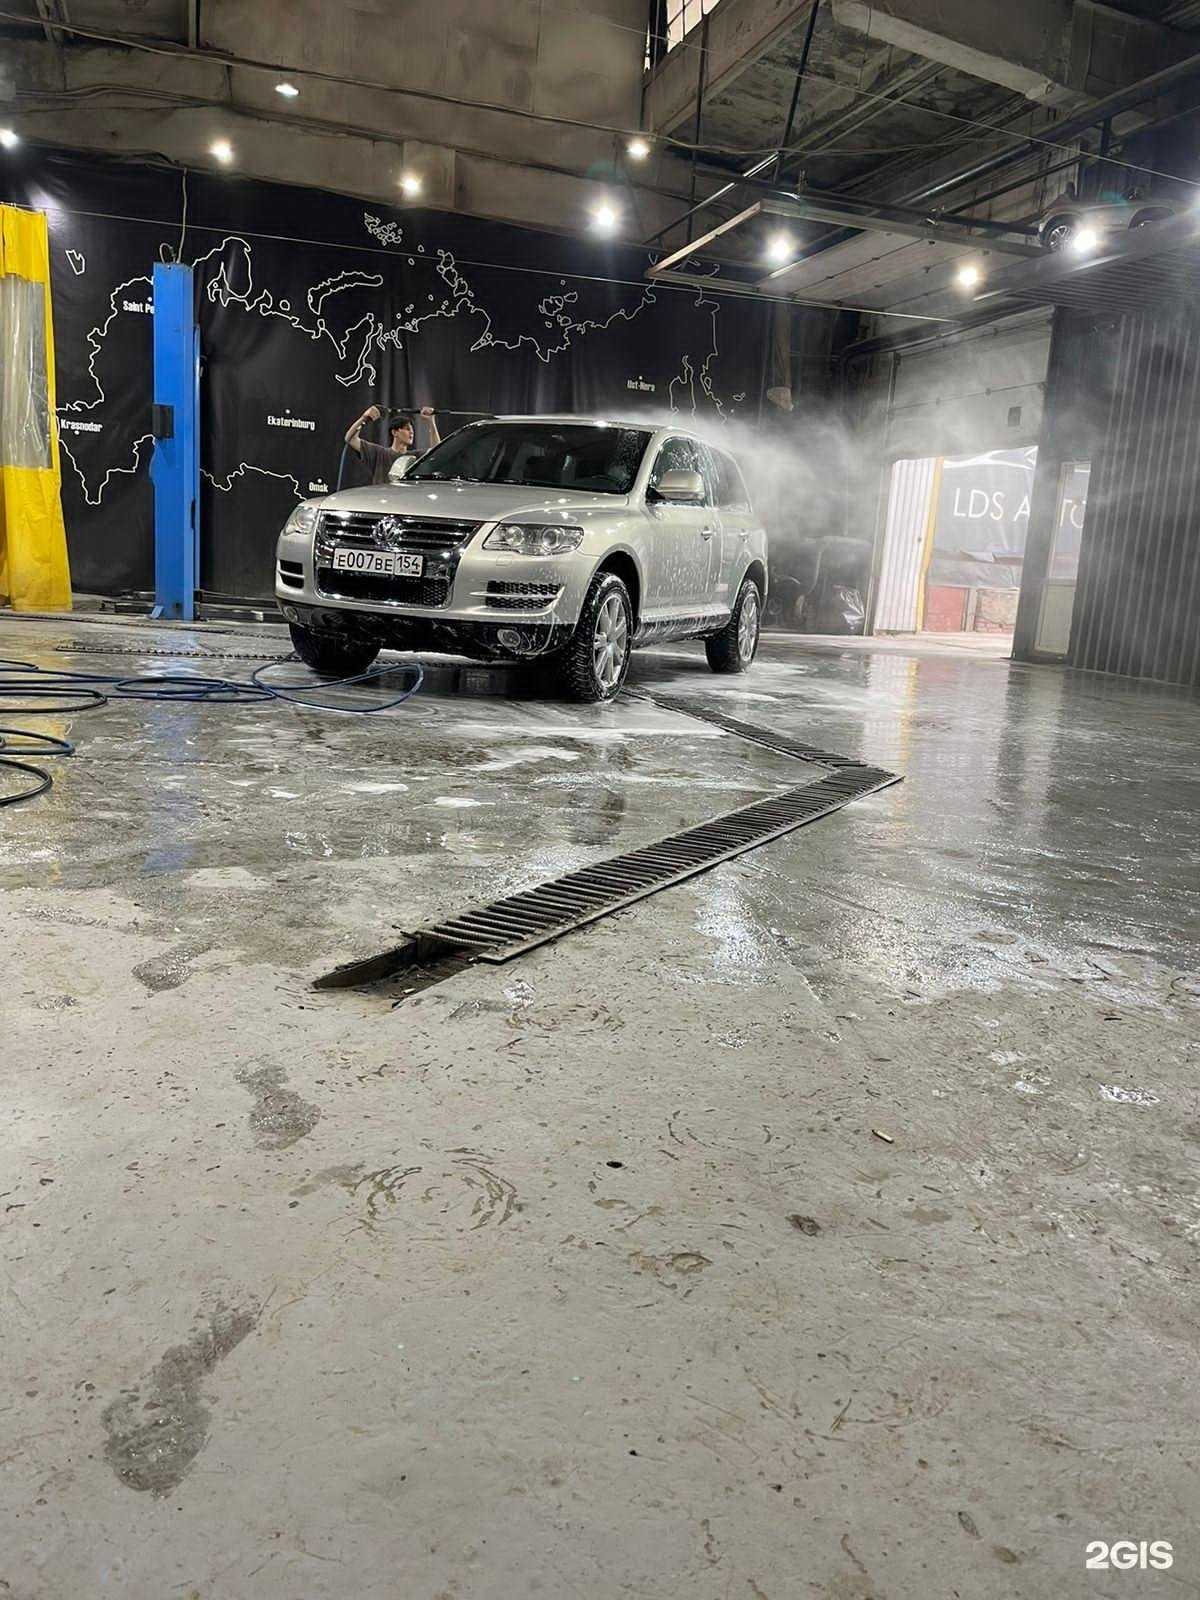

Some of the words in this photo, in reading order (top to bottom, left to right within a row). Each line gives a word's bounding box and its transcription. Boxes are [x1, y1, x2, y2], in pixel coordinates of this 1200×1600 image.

[123, 300, 144, 313] Saint
[60, 418, 103, 433] Krasnodar
[267, 415, 315, 431] Ekaterinburg
[309, 481, 328, 493] Omsk
[953, 487, 1006, 521] LDS
[1012, 495, 1087, 529] ATO
[397, 555, 421, 570] 154
